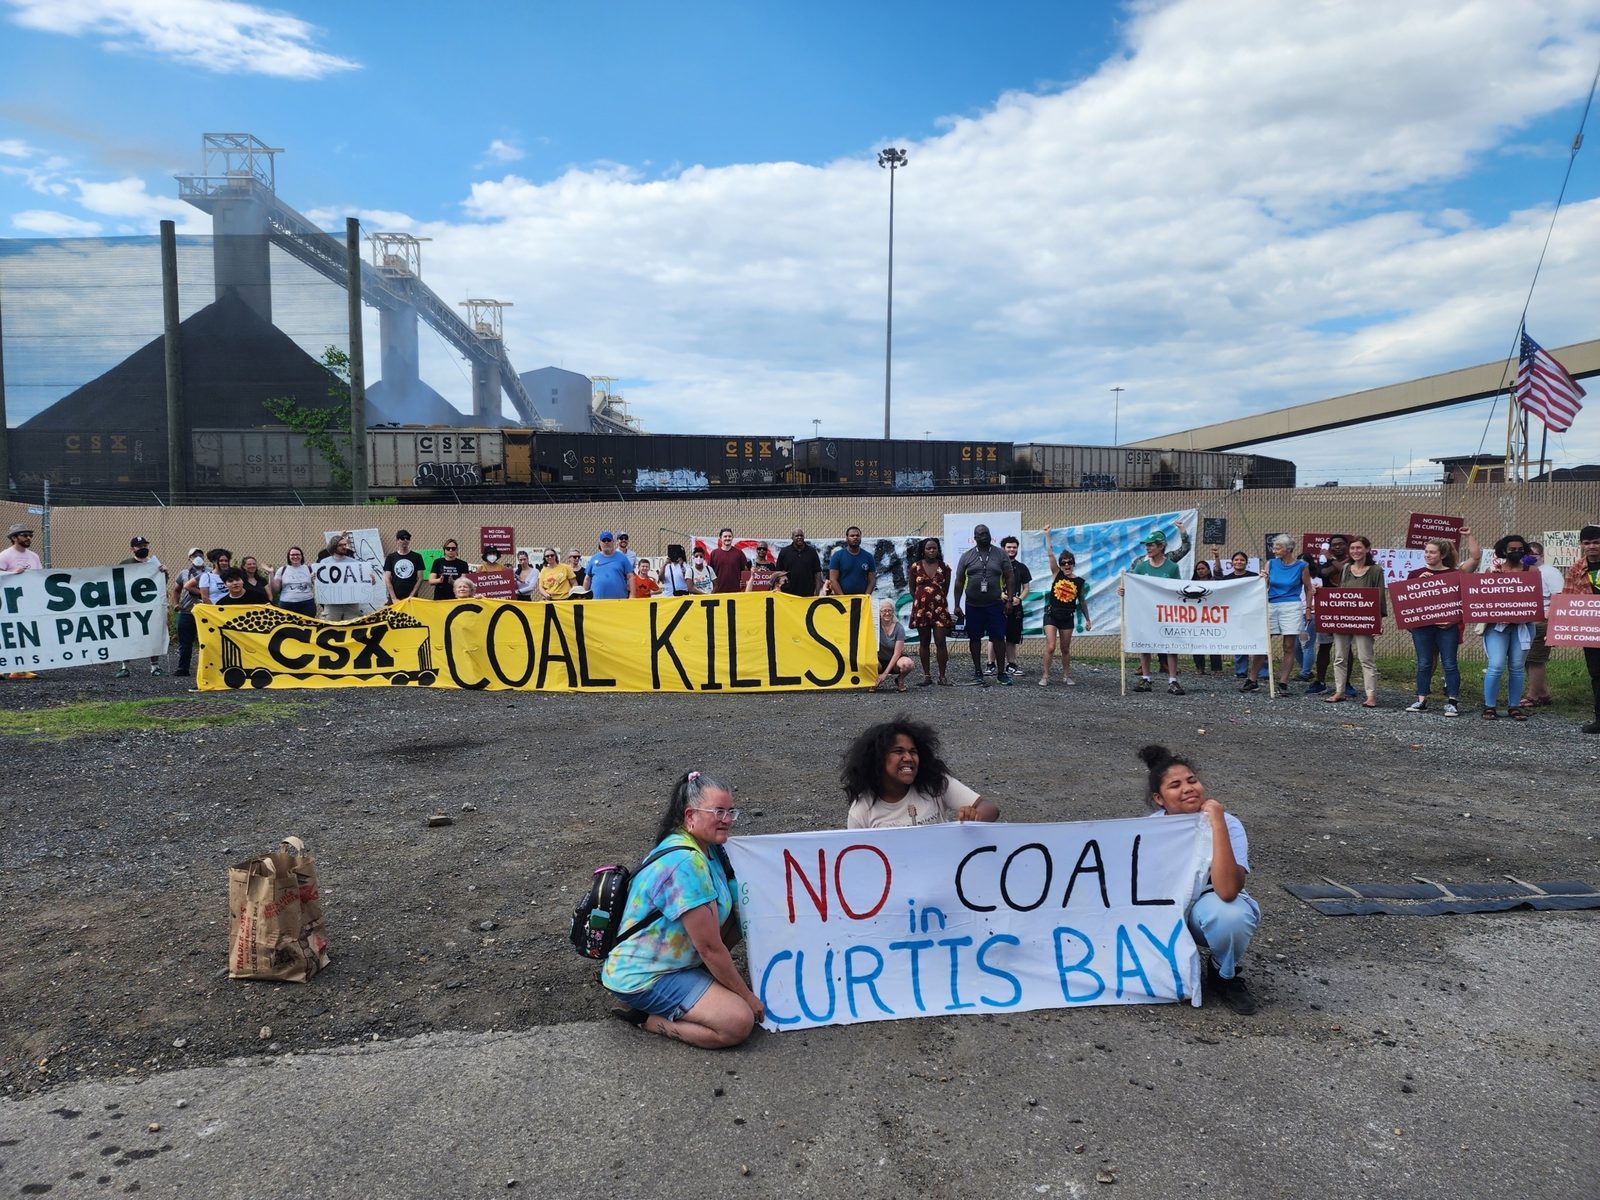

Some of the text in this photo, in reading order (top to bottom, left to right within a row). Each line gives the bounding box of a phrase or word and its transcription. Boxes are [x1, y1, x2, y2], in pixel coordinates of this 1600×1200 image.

[420, 436, 475, 450] CSX
[726, 441, 771, 454] CSX
[962, 447, 996, 458] CSX
[1128, 452, 1150, 462] CSX
[316, 564, 372, 584] COAL
[44, 568, 158, 612] Sale
[1407, 580, 1446, 592] NO COAL
[1409, 588, 1441, 600] CURTIS
[1442, 585, 1460, 594] BAY
[1201, 606, 1230, 624] ACT
[56, 610, 153, 645] PARTY
[1164, 628, 1222, 637] MARYLAND
[268, 622, 394, 670] CSX
[444, 603, 616, 690] COAL
[650, 598, 861, 690] KILLS!
[782, 834, 1176, 924] NO COAL
[908, 898, 946, 934] in
[759, 935, 1024, 1024] CURTIS
[1053, 919, 1184, 1003] BAY
